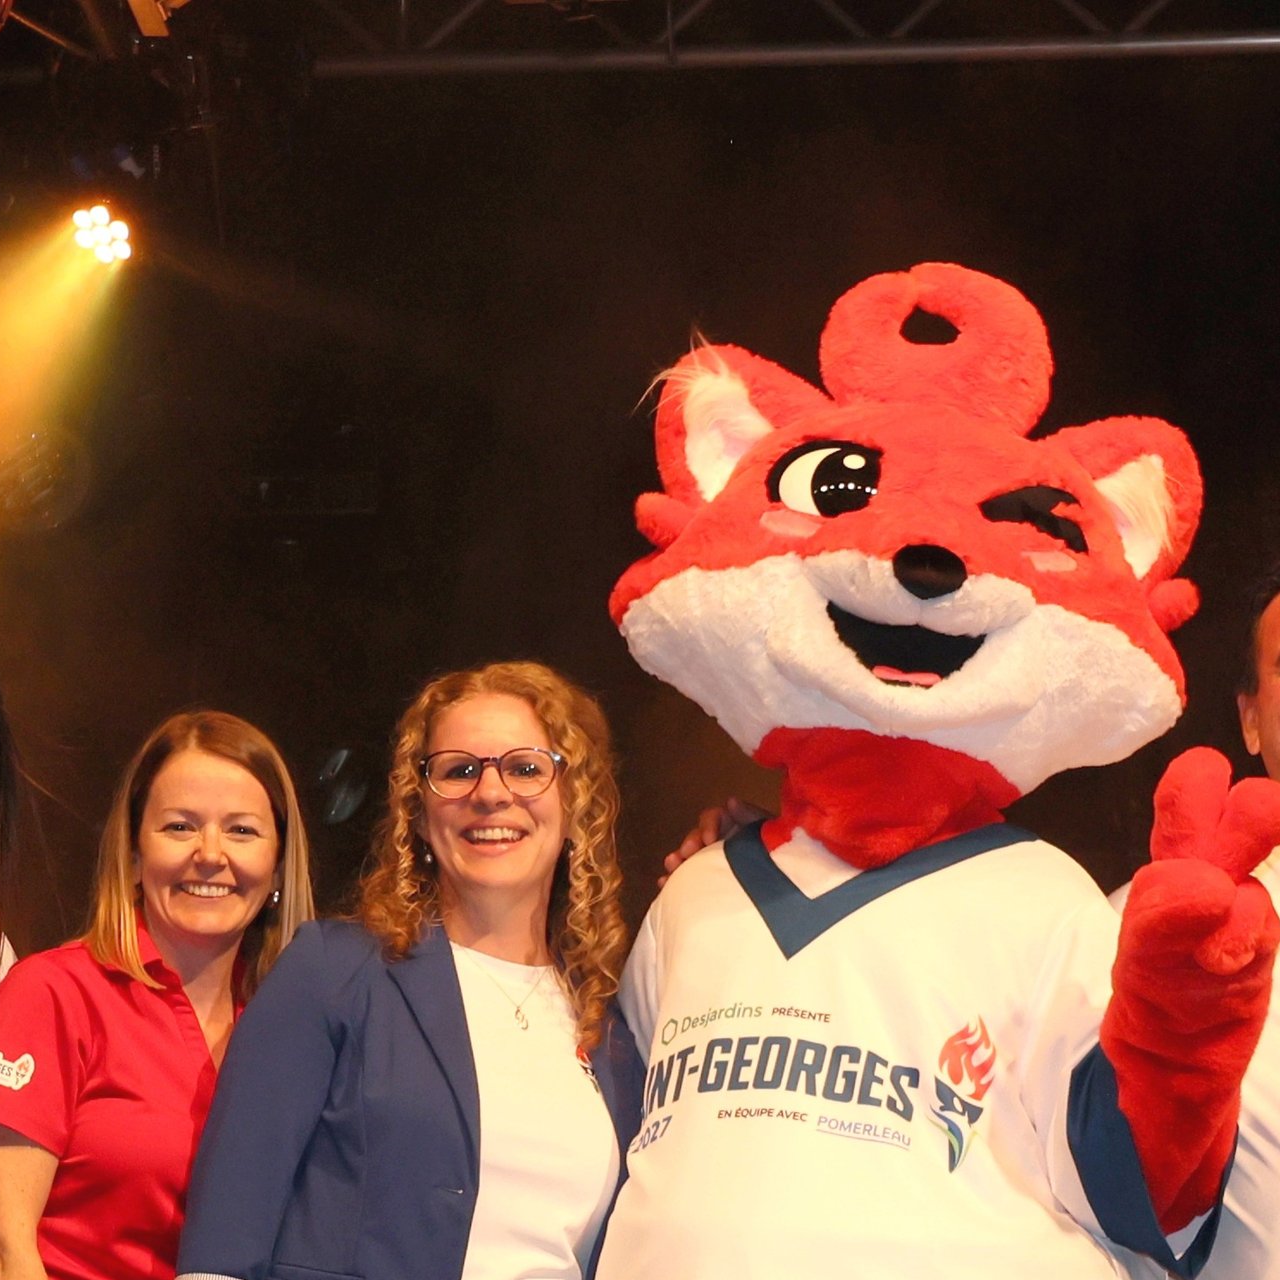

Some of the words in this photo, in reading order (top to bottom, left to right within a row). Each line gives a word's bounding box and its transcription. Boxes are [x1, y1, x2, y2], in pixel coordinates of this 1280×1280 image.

[681, 1003, 763, 1033] Desjardins
[771, 1006, 831, 1023] PRÉSENTE
[643, 1036, 920, 1122] INT-GEORGES
[717, 1109, 732, 1119] EN
[735, 1107, 774, 1118] ÉQUIPE
[776, 1109, 808, 1122] AVEC
[817, 1115, 911, 1147] POMERLEAU
